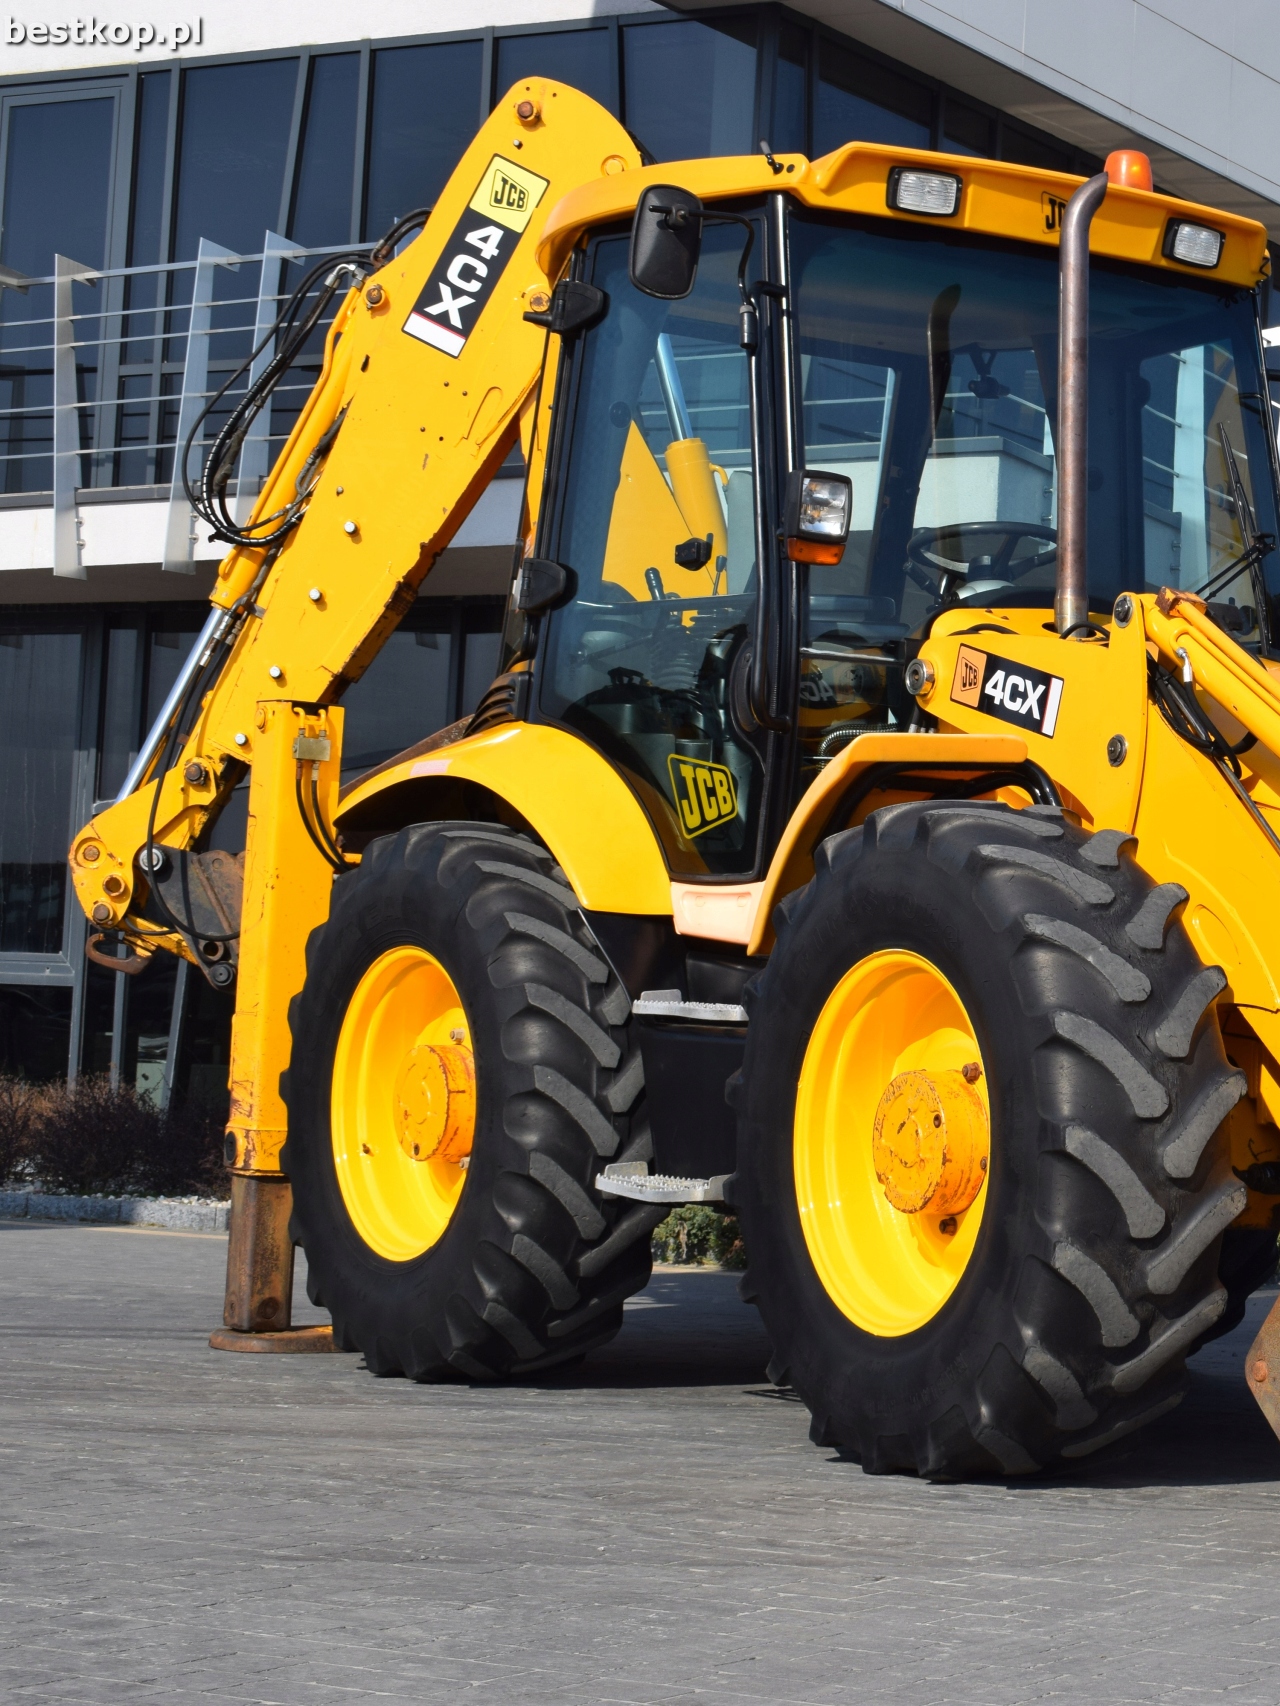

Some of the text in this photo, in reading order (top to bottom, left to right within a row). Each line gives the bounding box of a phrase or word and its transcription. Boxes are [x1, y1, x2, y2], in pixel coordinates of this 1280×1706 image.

[493, 175, 527, 209] JCB
[1045, 197, 1067, 230] JC
[423, 225, 505, 330] 4CX
[962, 661, 979, 689] JCB
[984, 669, 1047, 721] 4CX
[679, 763, 733, 829] JCB
